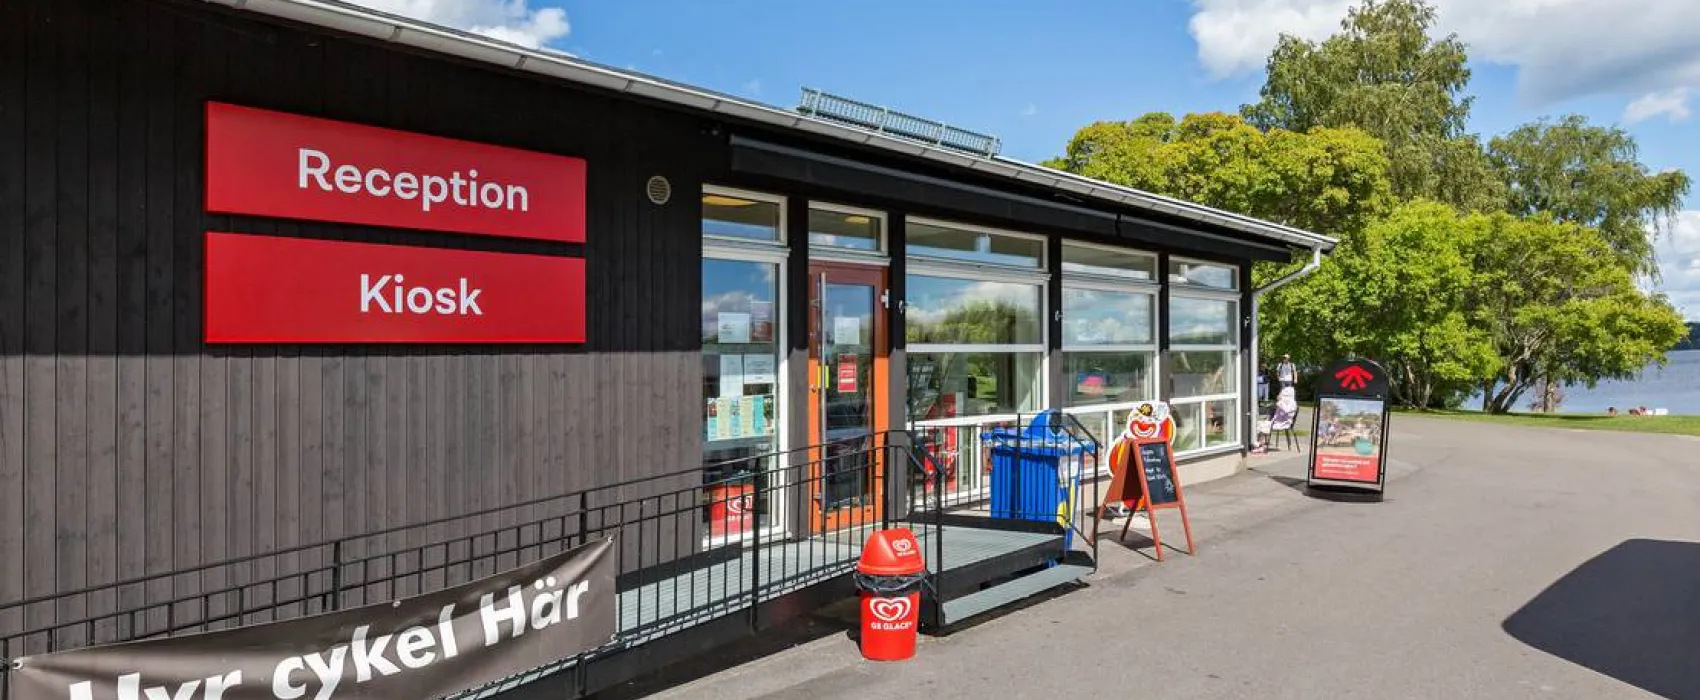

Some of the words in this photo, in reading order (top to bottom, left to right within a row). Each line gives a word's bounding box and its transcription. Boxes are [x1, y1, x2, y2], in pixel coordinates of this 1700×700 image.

[299, 148, 528, 212] Reception
[360, 273, 483, 315] Kiosk
[272, 604, 459, 700] cykel
[479, 575, 589, 647] Här
